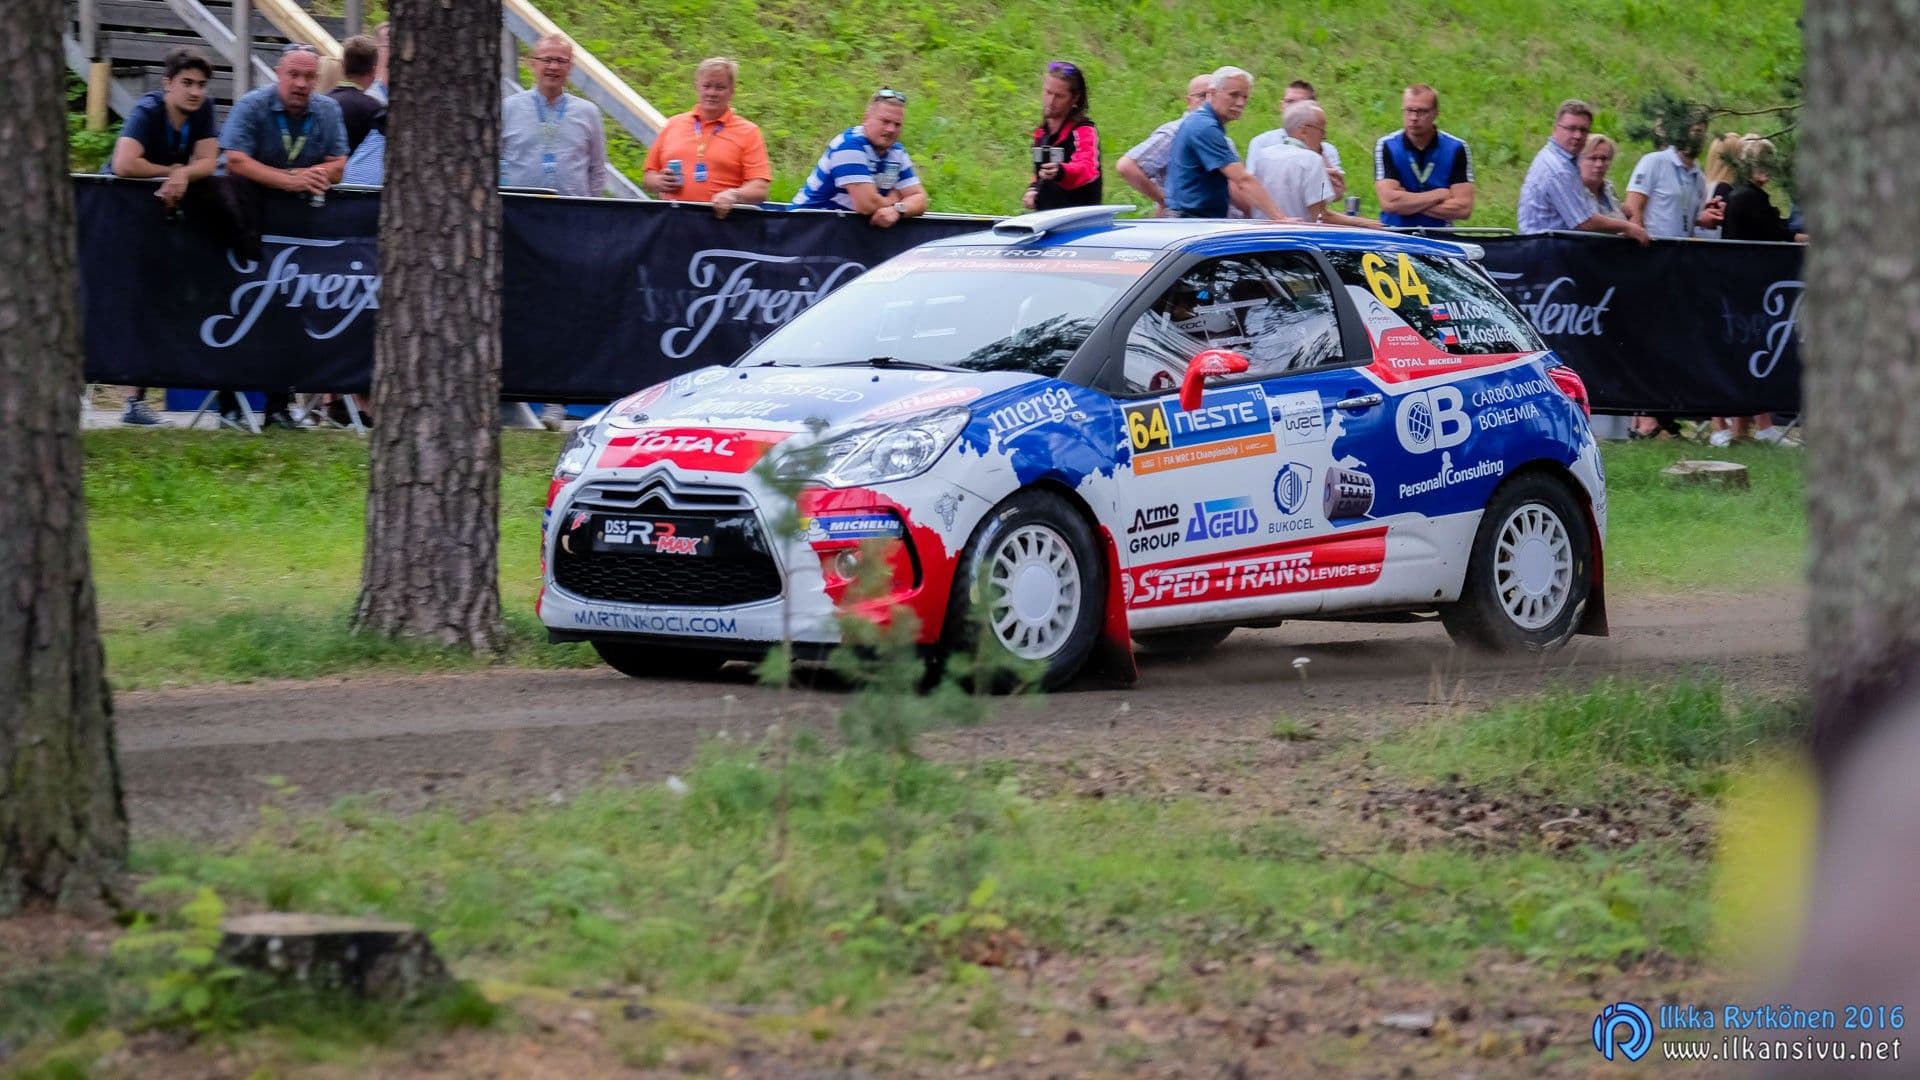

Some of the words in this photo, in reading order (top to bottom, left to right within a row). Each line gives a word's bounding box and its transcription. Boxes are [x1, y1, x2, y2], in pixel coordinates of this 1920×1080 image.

[1361, 253, 1431, 309] 64
[1388, 358, 1426, 368] TOTAL
[1428, 358, 1462, 366] MICHELIN
[1472, 378, 1549, 408] CARBOUNION
[987, 387, 1078, 434] merga
[1174, 401, 1258, 434] NESTE
[1478, 403, 1540, 431] BOHEMIA
[1128, 408, 1169, 449] 64
[1285, 415, 1323, 431] WRC
[631, 431, 735, 457] TOTAL
[1196, 446, 1239, 460] Championship
[1399, 471, 1443, 499] Personal
[1446, 459, 1504, 485] Consulting
[604, 520, 627, 535] DS3
[829, 519, 900, 532] MICHELIN
[1268, 518, 1314, 534] BUKOCEL
[656, 535, 701, 554] MAX
[1129, 531, 1180, 554] GROUP
[1311, 564, 1356, 581] LEVICE
[574, 610, 738, 633] MARTINKOCI.COM
